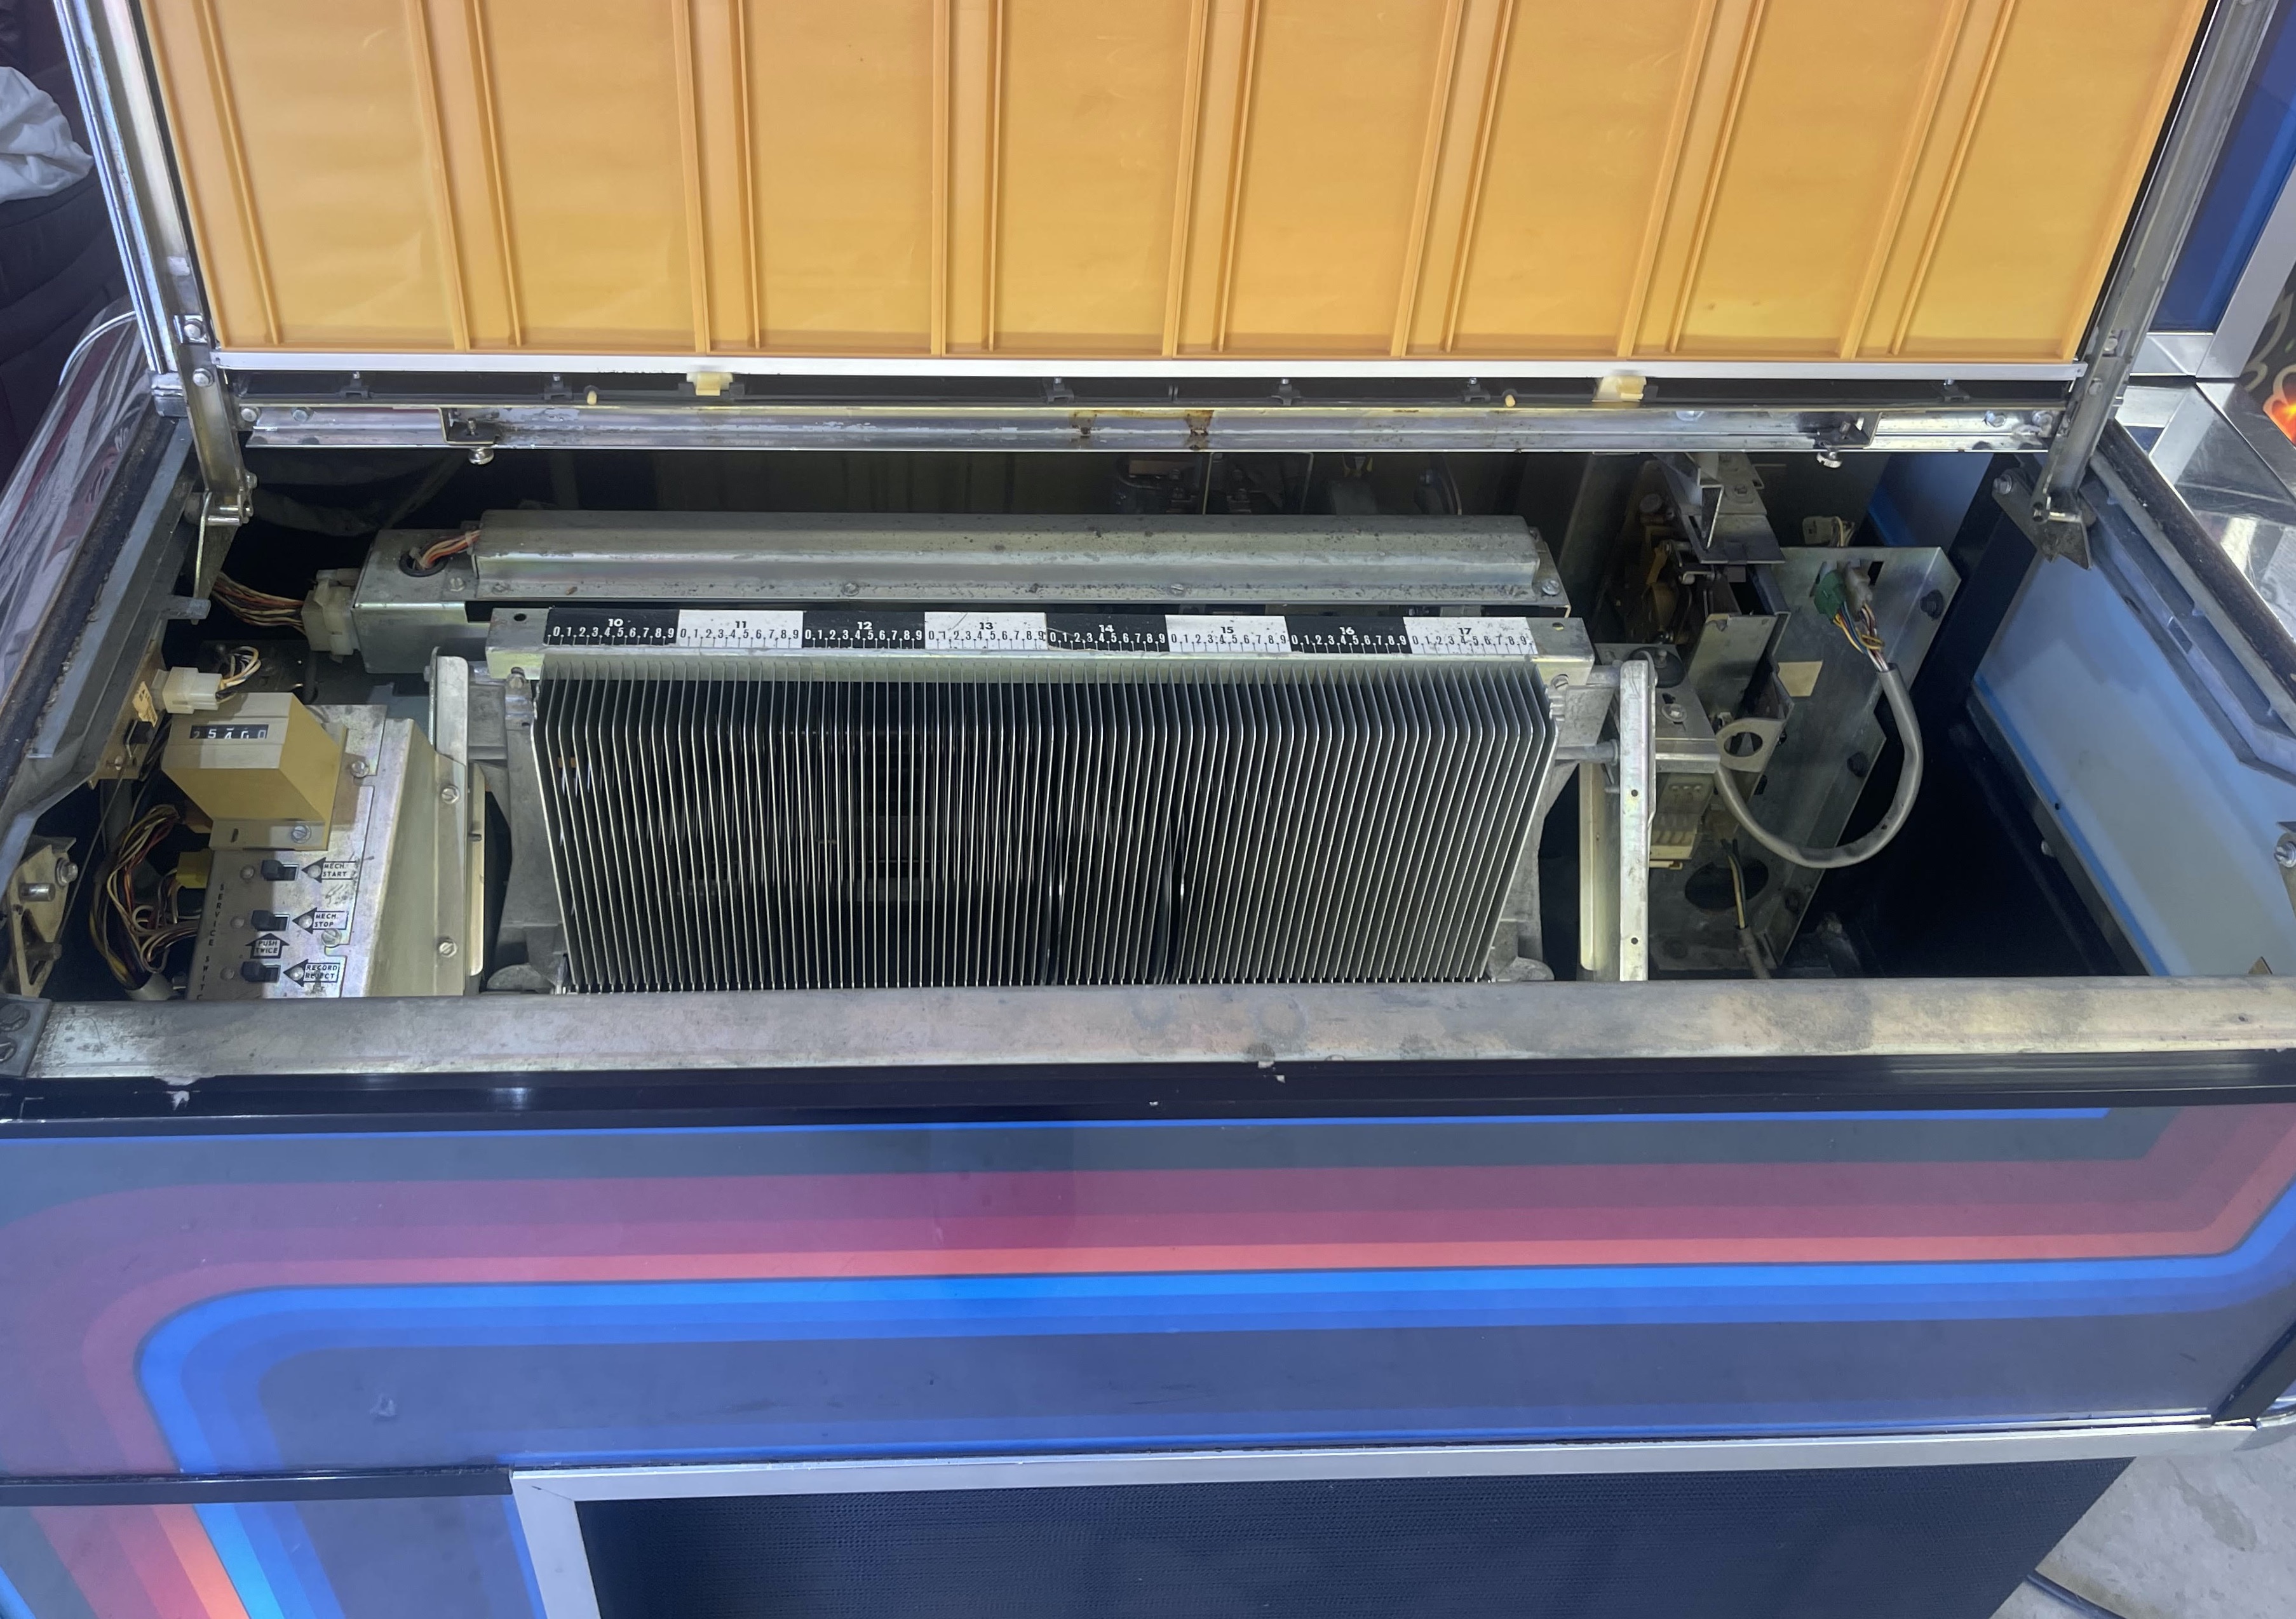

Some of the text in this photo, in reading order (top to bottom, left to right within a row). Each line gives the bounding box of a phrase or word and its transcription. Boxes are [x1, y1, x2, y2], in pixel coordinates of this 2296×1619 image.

[608, 618, 624, 627] 10
[735, 621, 746, 629] 11
[857, 621, 872, 630] 12
[979, 622, 994, 630] 13
[553, 626, 675, 638] 0 1 2 3 4 5 6 7 8 9
[1098, 624, 1114, 633] 14
[1339, 626, 1355, 635] 16
[680, 628, 799, 640] 0 1 2 3 4 5 6 7 8 9
[804, 629, 922, 641] 0 1 2 3 4 5 6 7 8 9
[928, 630, 1044, 641] 0 1 2 3 4 5 6 7 8 9
[1050, 631, 1165, 643] 0 1 2 3 4 5 6 7 8 9
[1171, 633, 1286, 644] 0 1 2 3 4 5 6 7 8 9
[1291, 635, 1407, 645] 0 1 2 3 4 5 6 7 8 9
[1412, 635, 1527, 645] 0 1 2 3 4 5 6 7 8 9
[208, 883, 224, 946] SERVICE
